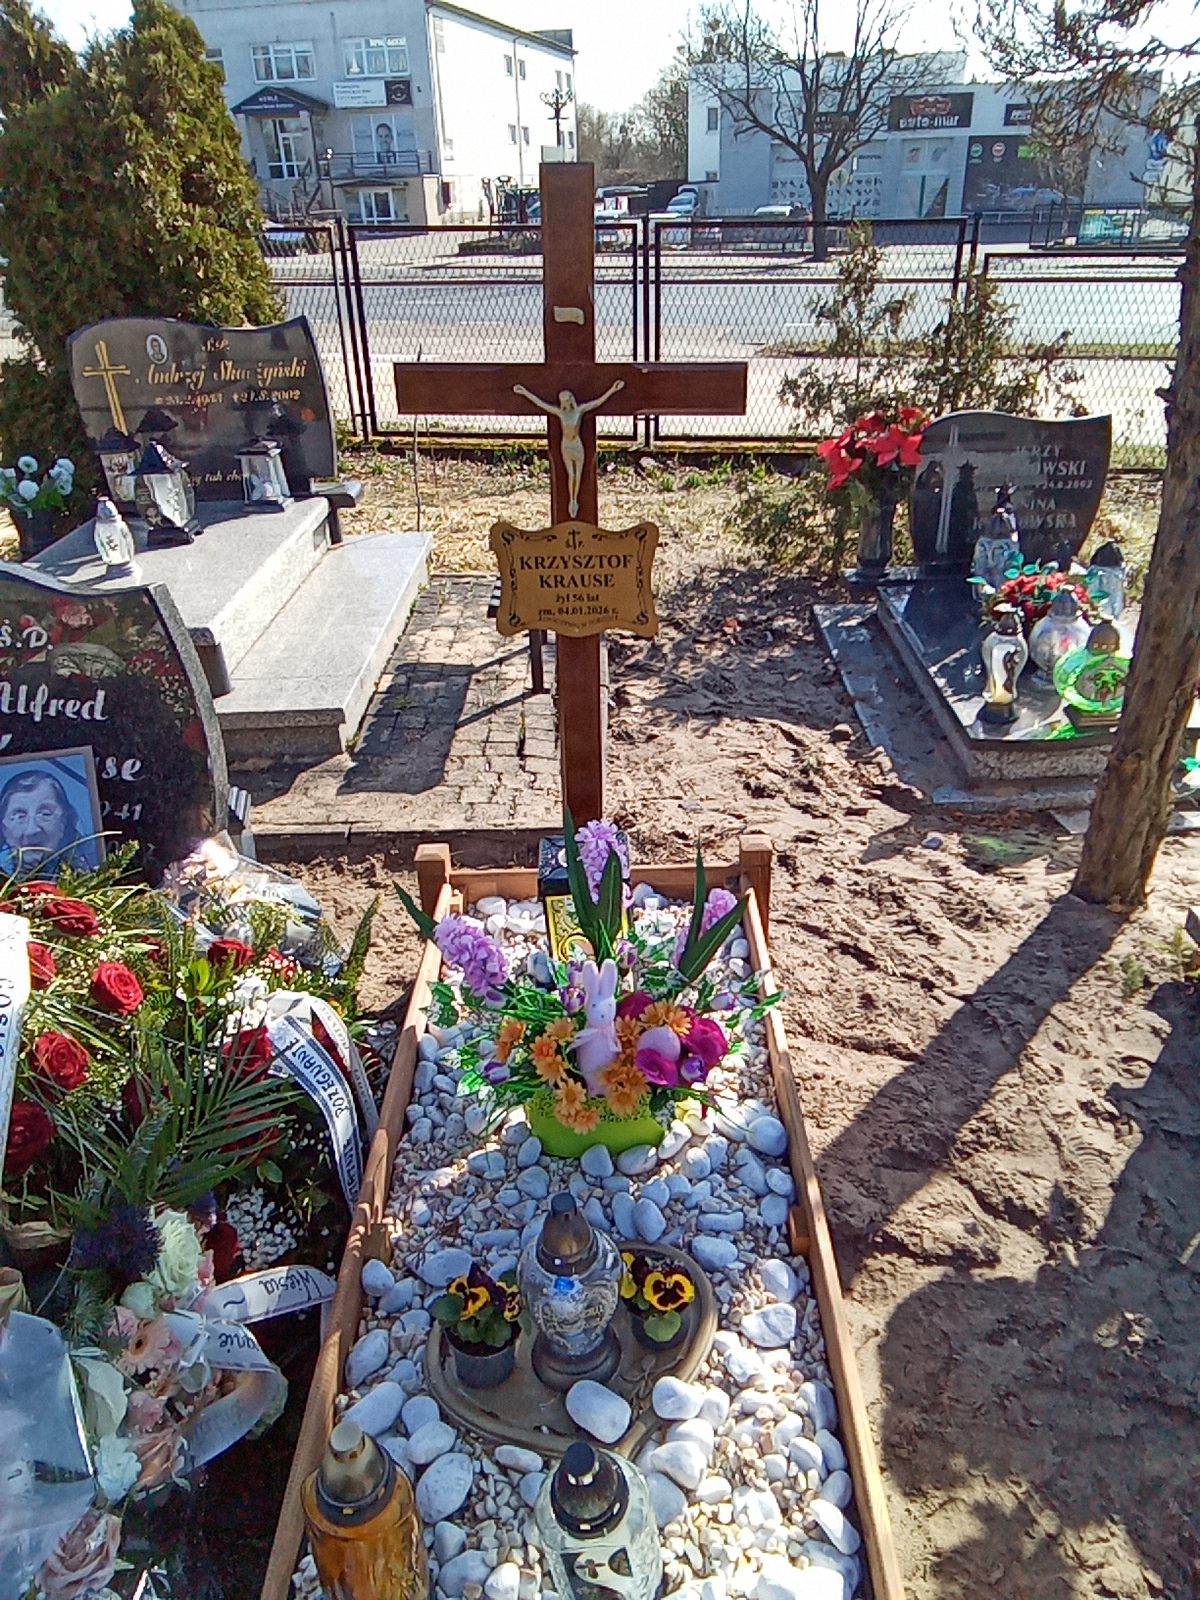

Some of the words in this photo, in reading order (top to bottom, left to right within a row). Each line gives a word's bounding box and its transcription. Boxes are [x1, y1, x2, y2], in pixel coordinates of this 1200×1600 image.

[519, 554, 634, 570] KRZYSZTOF
[539, 573, 616, 589] KRAUSE
[572, 594, 585, 603] 56
[586, 592, 600, 603] lat
